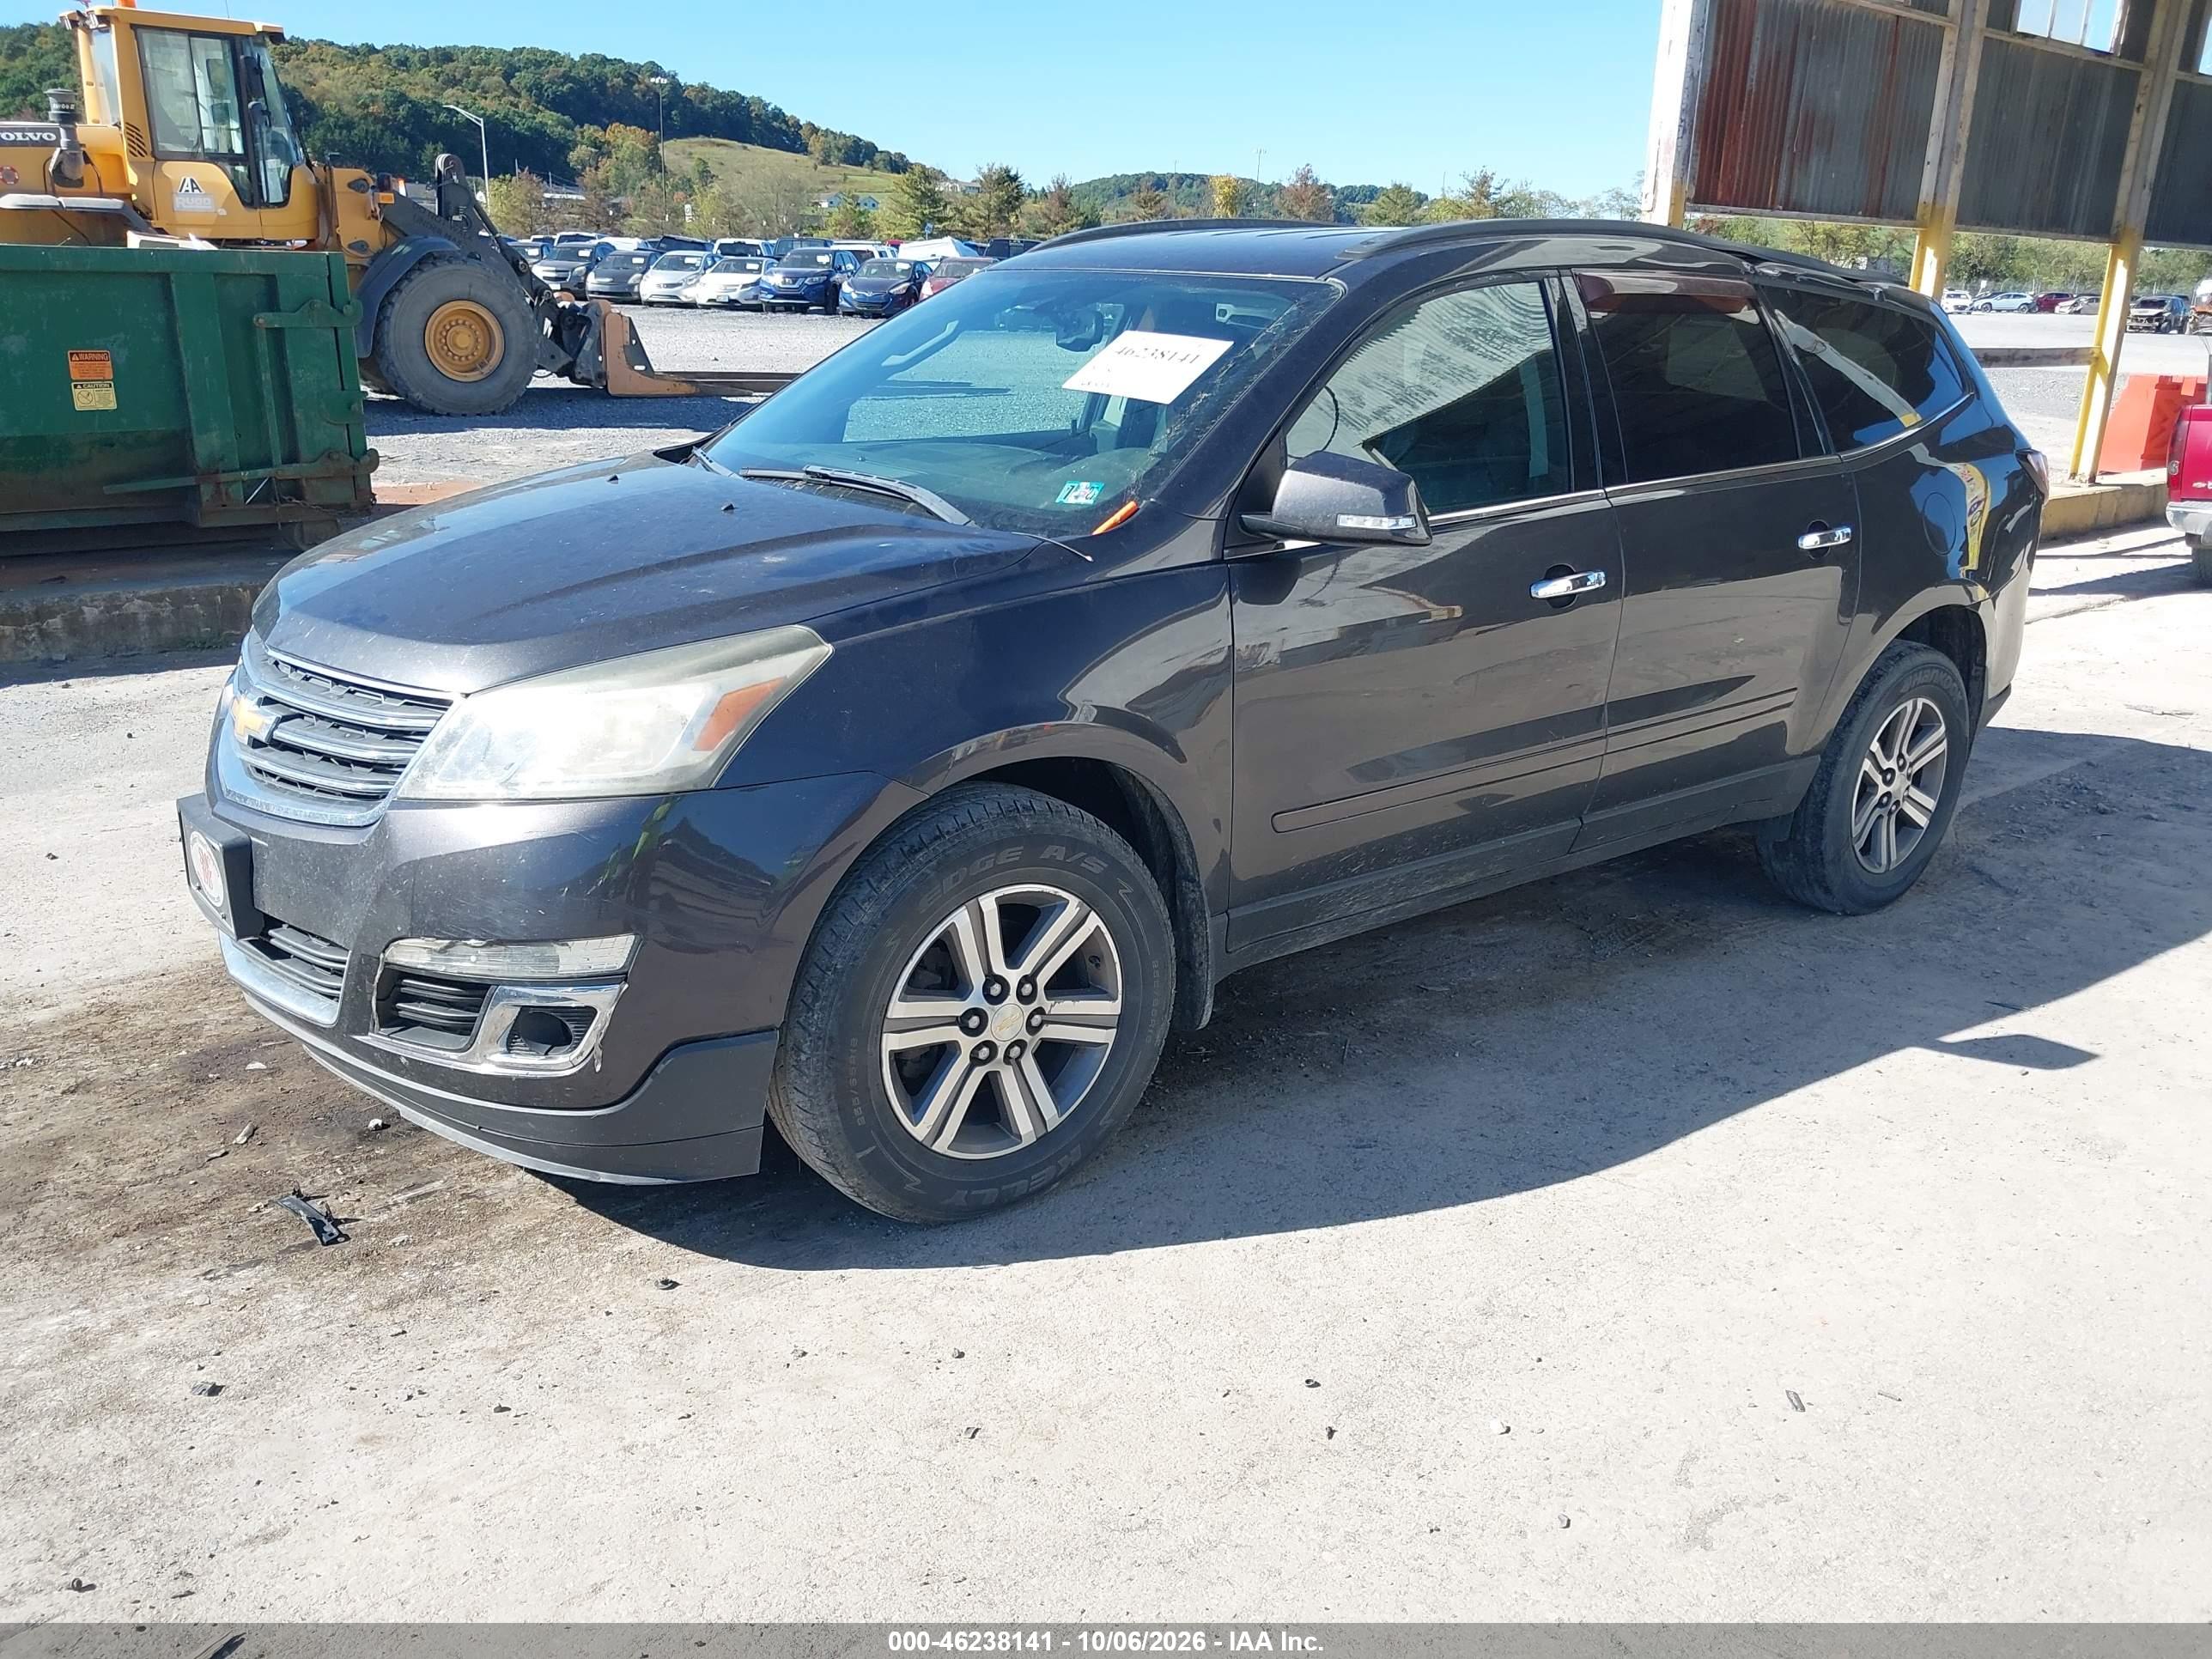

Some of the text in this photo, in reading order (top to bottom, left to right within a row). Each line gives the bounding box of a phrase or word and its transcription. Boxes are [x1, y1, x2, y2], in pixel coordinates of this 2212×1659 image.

[0, 132, 57, 141] OLVO
[919, 845, 1109, 914] EDGE A/S
[941, 1143, 1083, 1206] KELLY
